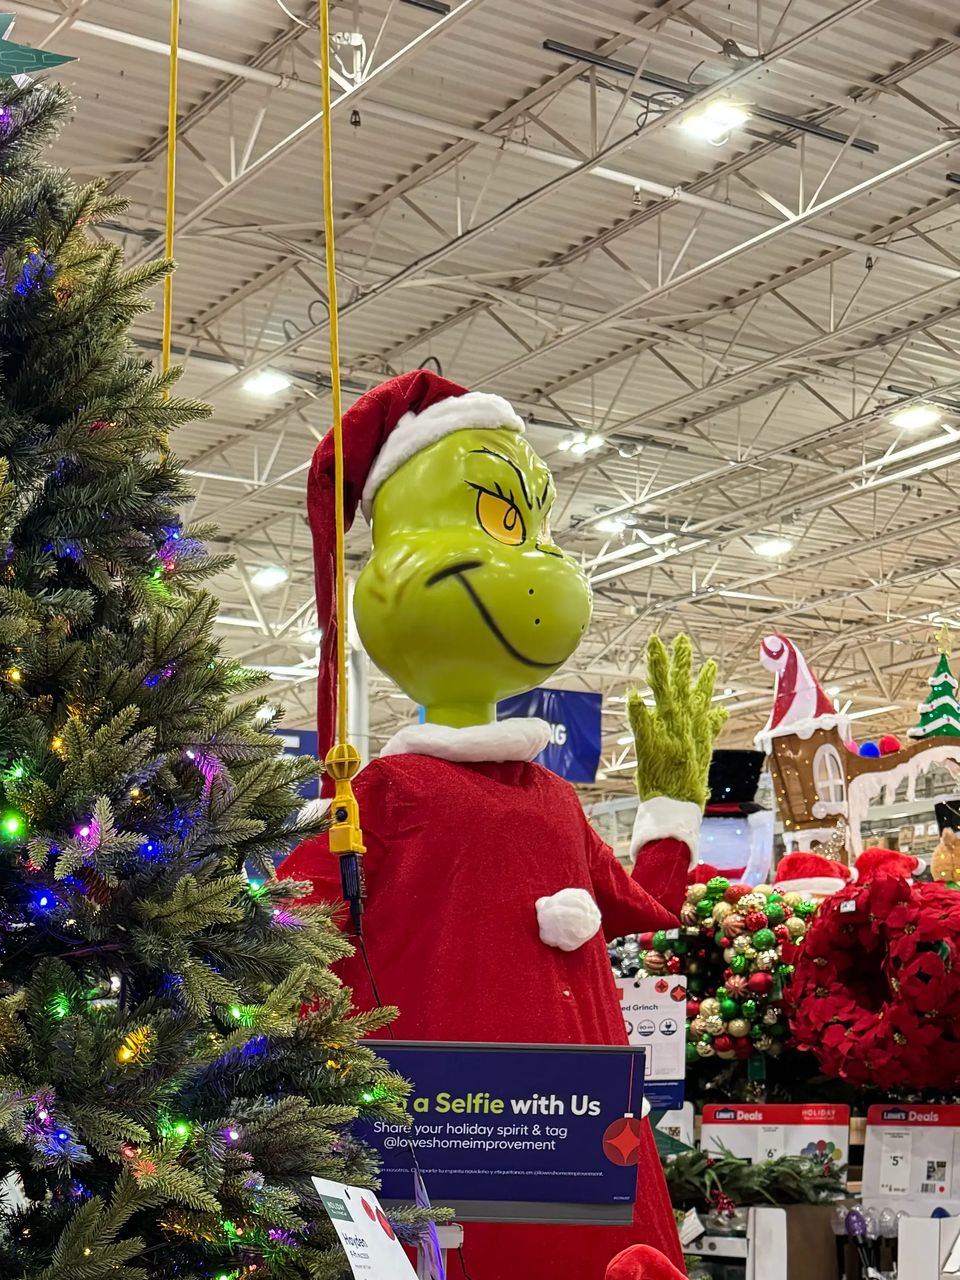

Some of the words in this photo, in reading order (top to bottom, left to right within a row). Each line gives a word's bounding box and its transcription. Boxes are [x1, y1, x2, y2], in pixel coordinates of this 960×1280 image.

[413, 1097, 429, 1113] a
[435, 1092, 504, 1114] Selfie
[510, 1094, 564, 1116] with
[570, 1094, 601, 1116] Us
[737, 1110, 763, 1120] Deals
[802, 1109, 836, 1117] HOLIDAY
[908, 1111, 939, 1121] Deals
[373, 1121, 411, 1134] Share
[414, 1125, 444, 1136] your
[446, 1123, 494, 1137] holiday
[496, 1124, 529, 1138] spirit
[531, 1125, 542, 1136] &
[545, 1126, 568, 1138] tag
[383, 1136, 556, 1151] @loweshomeimprovement
